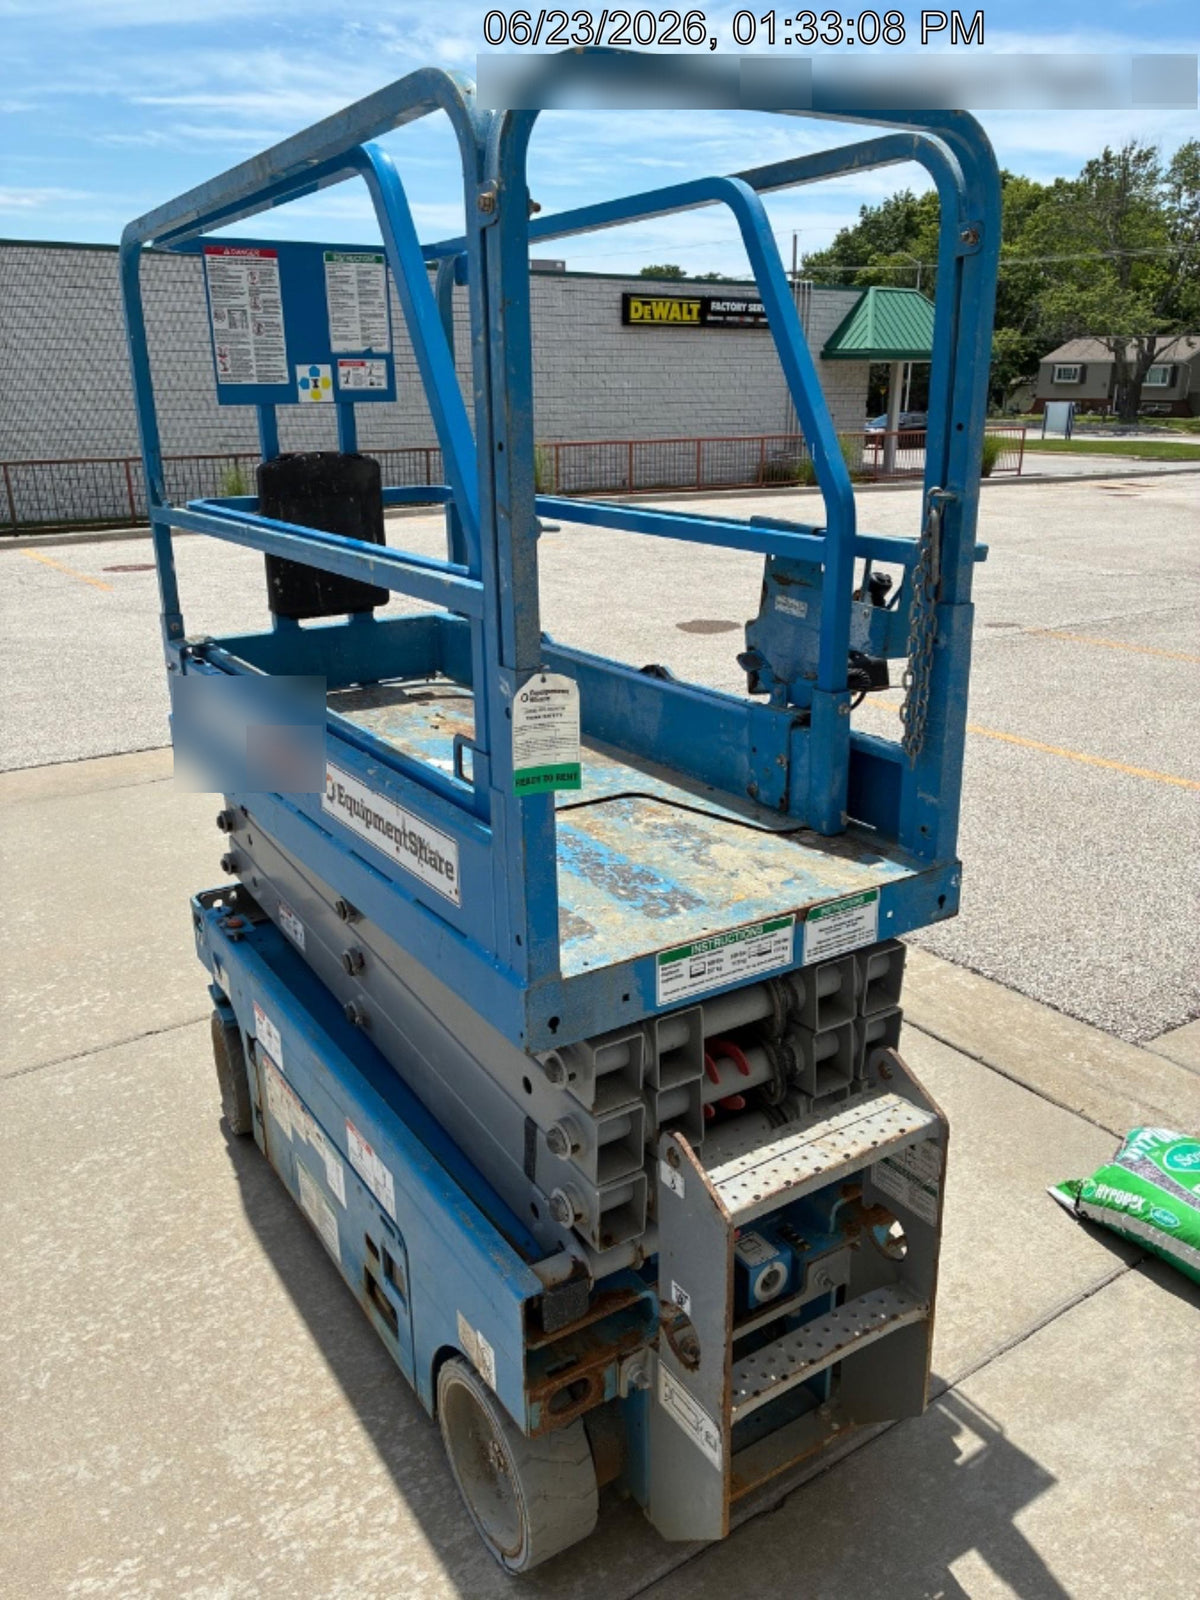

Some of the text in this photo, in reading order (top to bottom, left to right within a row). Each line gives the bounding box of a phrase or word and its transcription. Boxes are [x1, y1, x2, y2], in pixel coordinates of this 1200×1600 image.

[711, 301, 747, 312] FACTORY
[556, 772, 577, 782] RENT
[337, 783, 454, 882] EquipmentShare
[691, 924, 764, 956] INSTRUCTIONS
